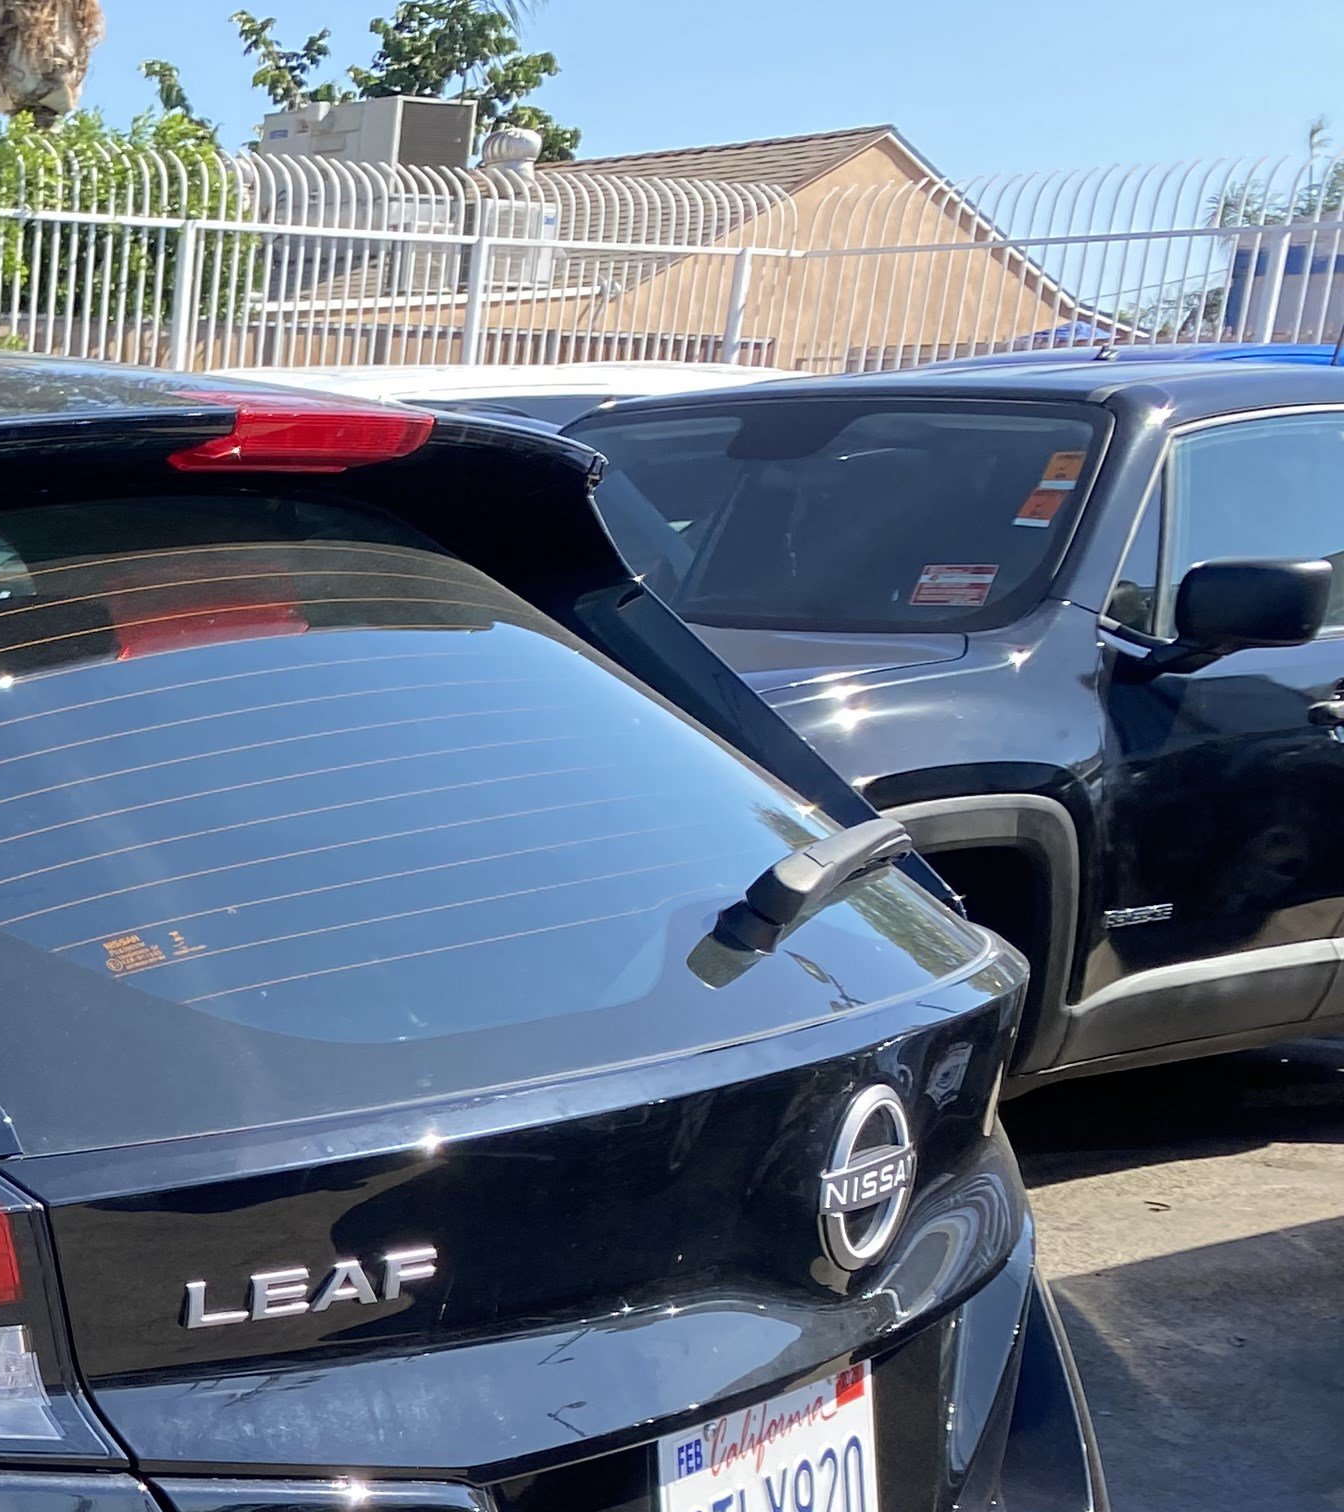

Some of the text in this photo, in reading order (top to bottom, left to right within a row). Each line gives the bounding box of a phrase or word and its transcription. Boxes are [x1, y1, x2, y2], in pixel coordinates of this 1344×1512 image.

[184, 1244, 438, 1329] LEAF
[677, 1396, 838, 1478] FEB California
